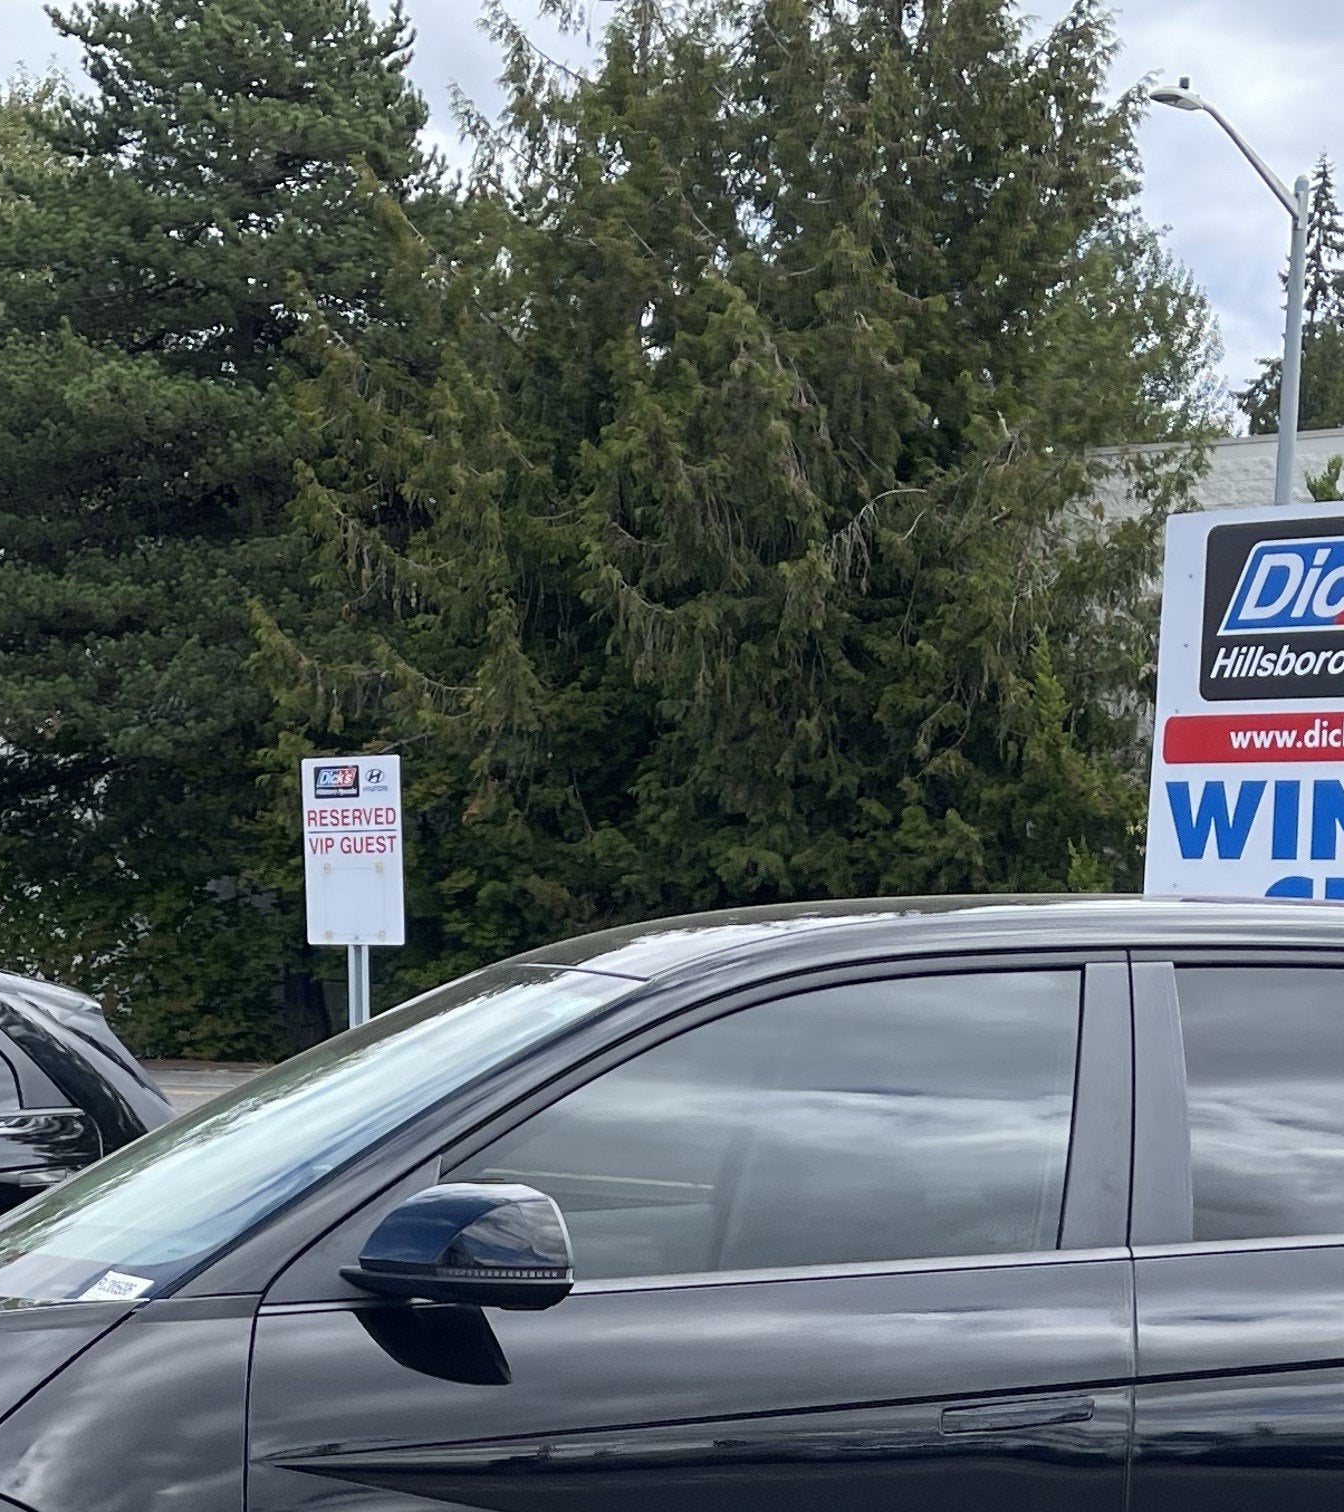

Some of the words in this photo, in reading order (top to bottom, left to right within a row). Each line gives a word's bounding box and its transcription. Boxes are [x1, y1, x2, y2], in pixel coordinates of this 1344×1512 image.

[307, 807, 397, 828] RESERVED
[309, 836, 335, 855] VIP
[339, 835, 397, 854] GUEST
